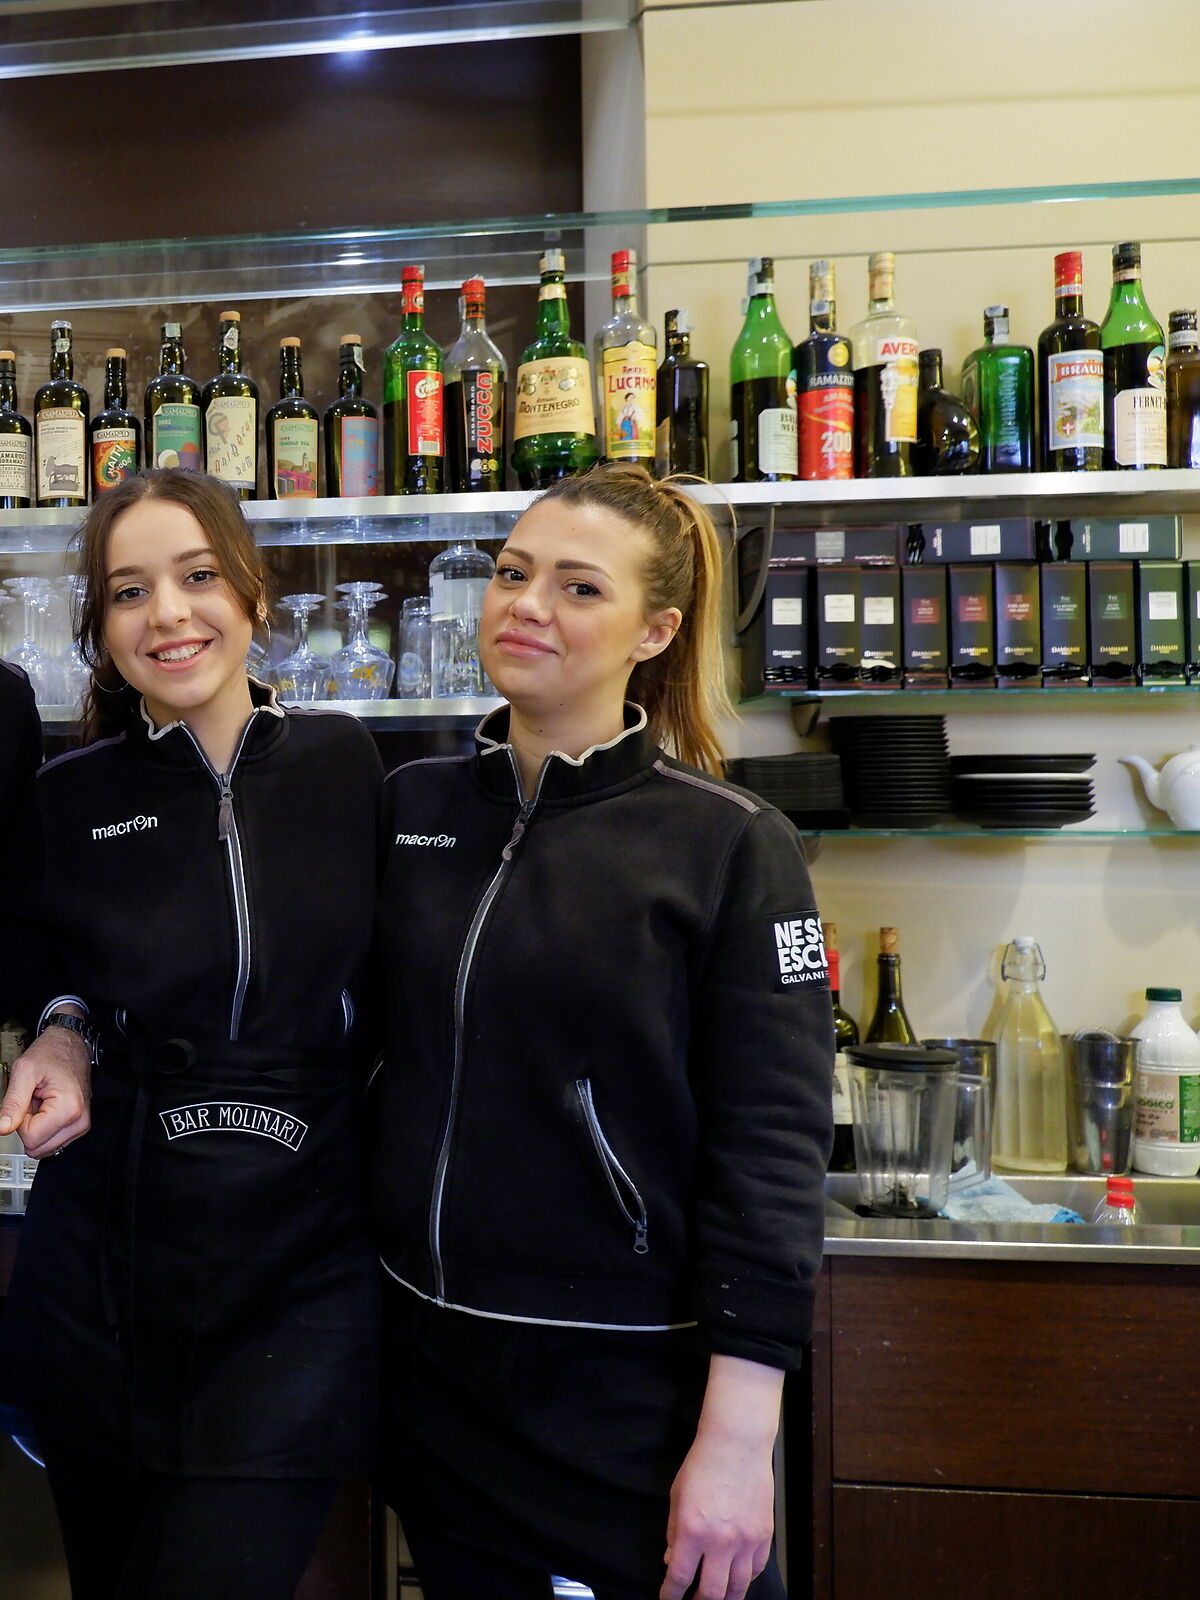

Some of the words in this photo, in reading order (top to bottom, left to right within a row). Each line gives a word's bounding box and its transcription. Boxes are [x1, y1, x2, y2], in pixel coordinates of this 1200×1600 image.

[518, 399, 580, 414] MONTENEGRO
[92, 815, 158, 840] macron
[395, 834, 457, 848] macron
[170, 1108, 211, 1133] BAR
[218, 1106, 300, 1143] MOLINARI
